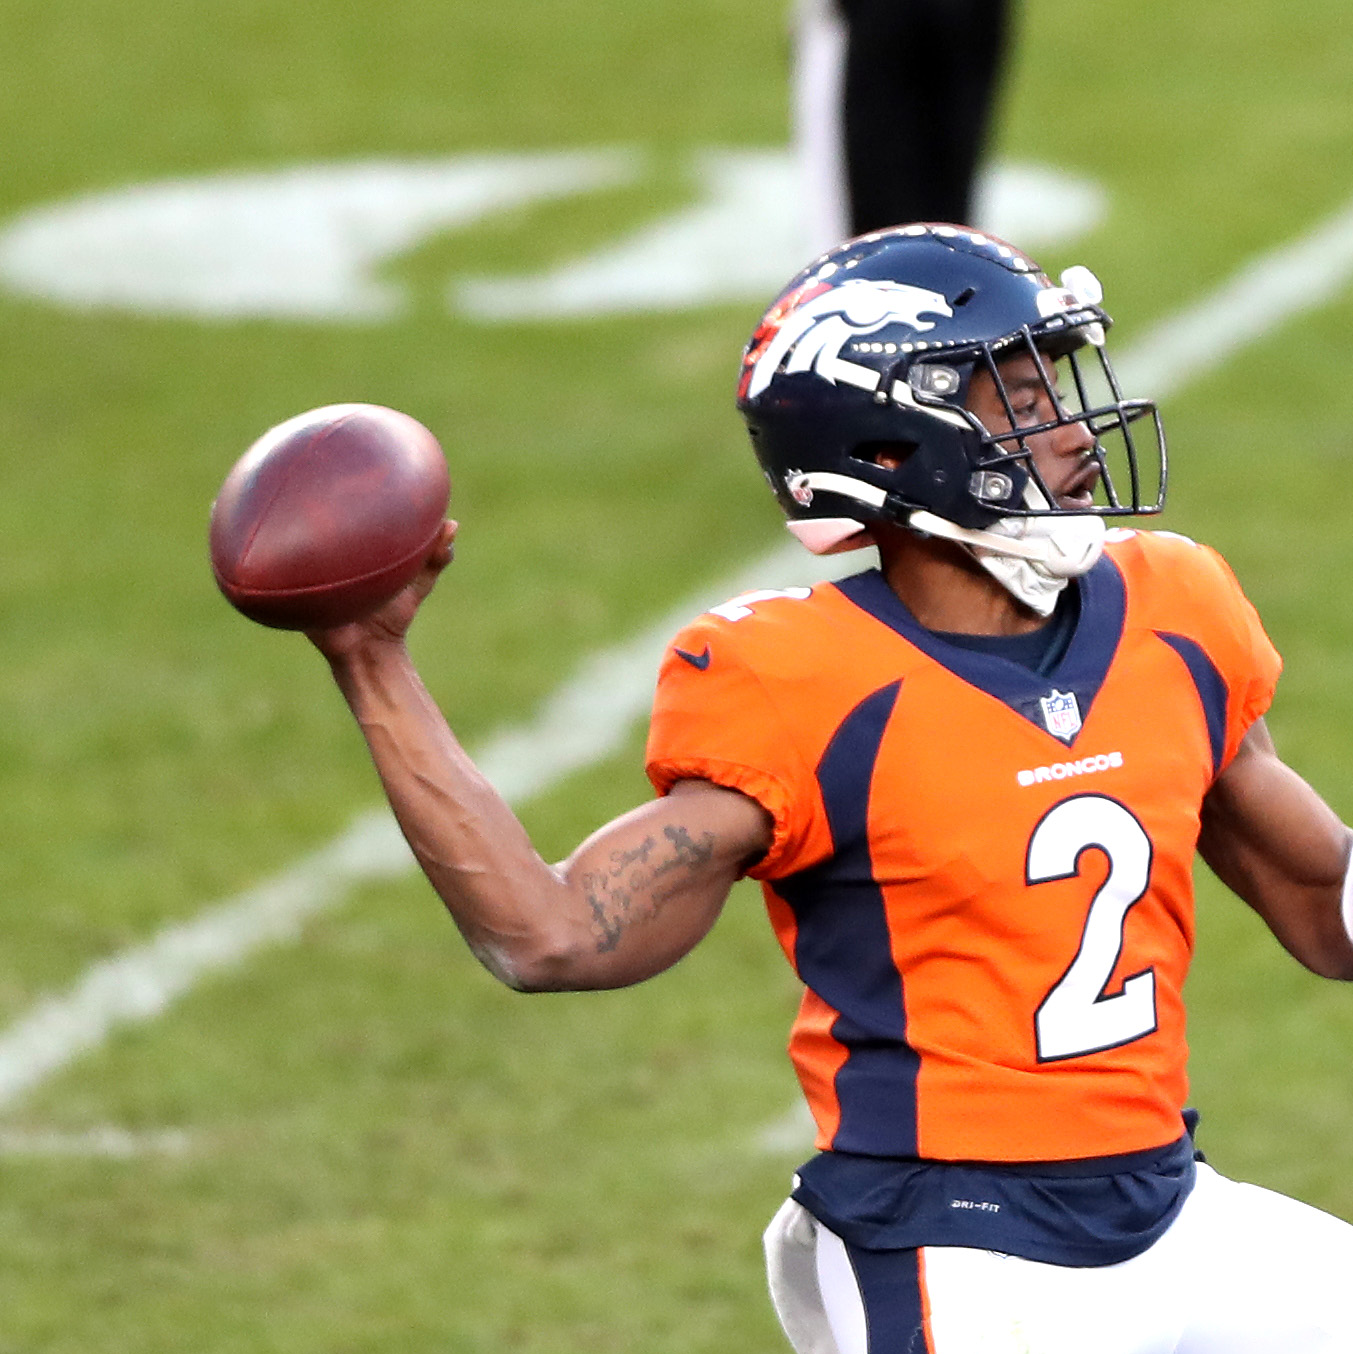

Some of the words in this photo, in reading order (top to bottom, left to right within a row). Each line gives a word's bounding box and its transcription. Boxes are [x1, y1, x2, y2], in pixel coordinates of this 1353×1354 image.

[1052, 712, 1076, 729] NFL
[1017, 751, 1123, 786] BRONCOS
[1025, 792, 1158, 1064] 2
[951, 1200, 1000, 1213] DRI-FIT
